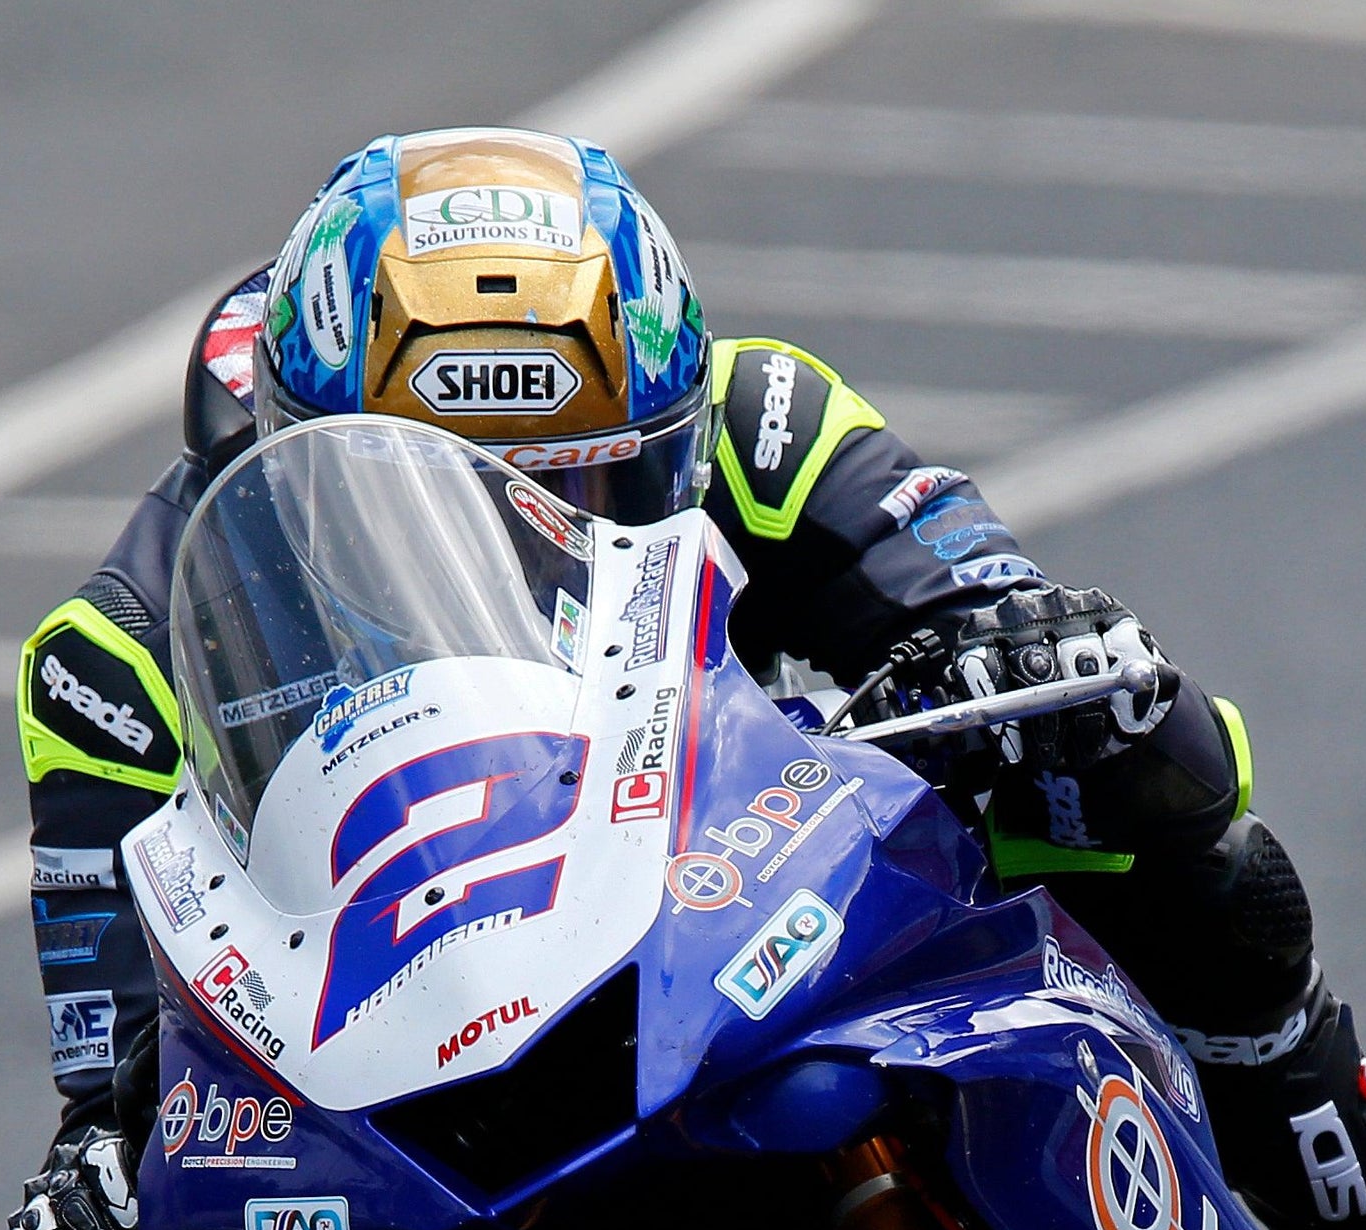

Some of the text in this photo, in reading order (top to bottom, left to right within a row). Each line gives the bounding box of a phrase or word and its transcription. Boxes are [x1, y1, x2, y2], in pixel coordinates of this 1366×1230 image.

[414, 225, 575, 250] SOLUTIONS LTD
[436, 186, 559, 231] CDI
[323, 263, 337, 314] Robinson
[332, 322, 347, 352] Sons
[436, 364, 556, 401] SHOEI
[752, 353, 798, 472] spada
[502, 437, 638, 468] Care
[39, 654, 155, 756] spada
[221, 674, 339, 724] METZELER
[315, 669, 412, 737] CAFFREY
[321, 709, 421, 776] METZELER
[614, 687, 678, 822] IC Racing
[704, 758, 831, 858] bpe
[759, 855, 785, 881] BOYCE
[783, 814, 823, 855] PRECISION
[311, 731, 592, 1052] 2
[193, 945, 286, 1062] IC Racing
[343, 906, 524, 1032] HARRISON
[437, 1000, 540, 1069] MOTUL
[197, 1083, 293, 1154] bpe
[183, 1157, 295, 1167] BOYCE PRECISION ENGINEERING
